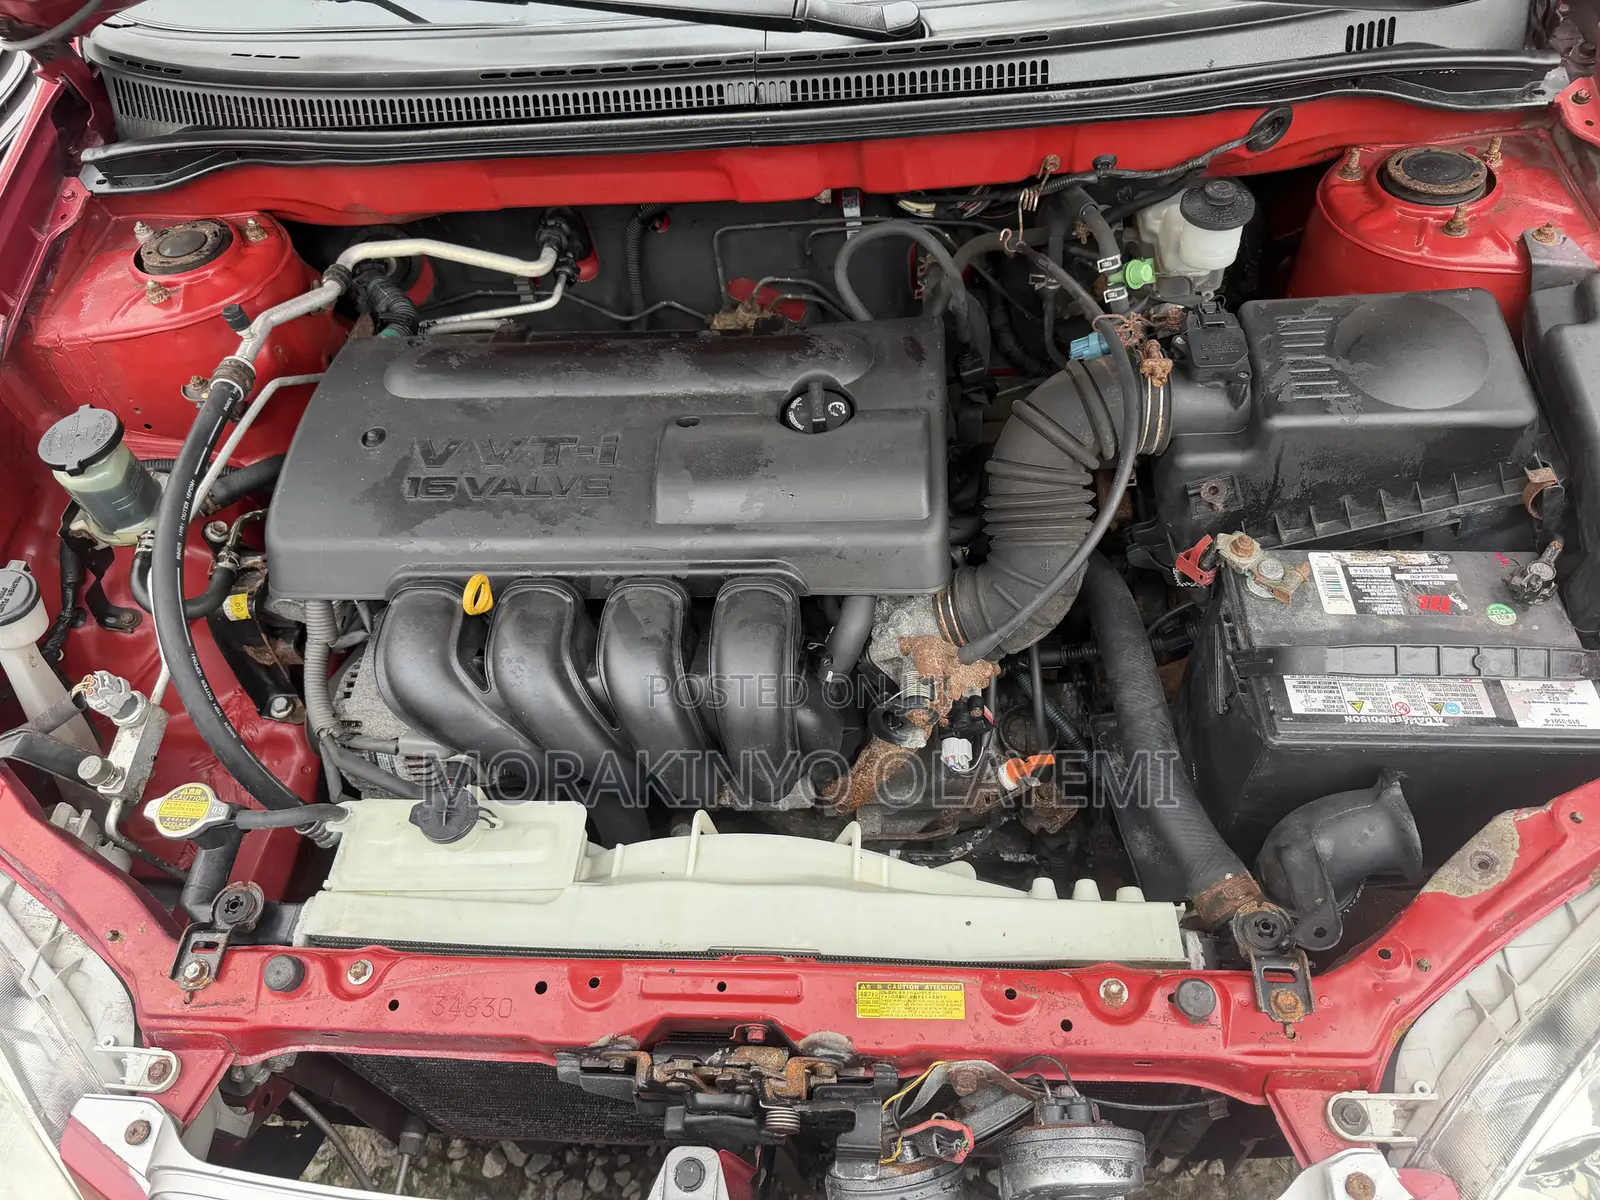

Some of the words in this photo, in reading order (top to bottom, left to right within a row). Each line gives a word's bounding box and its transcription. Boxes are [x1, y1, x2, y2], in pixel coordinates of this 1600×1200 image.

[181, 501, 190, 521] OUTER
[200, 679, 214, 701] OUTER
[431, 995, 513, 1019] 34630
